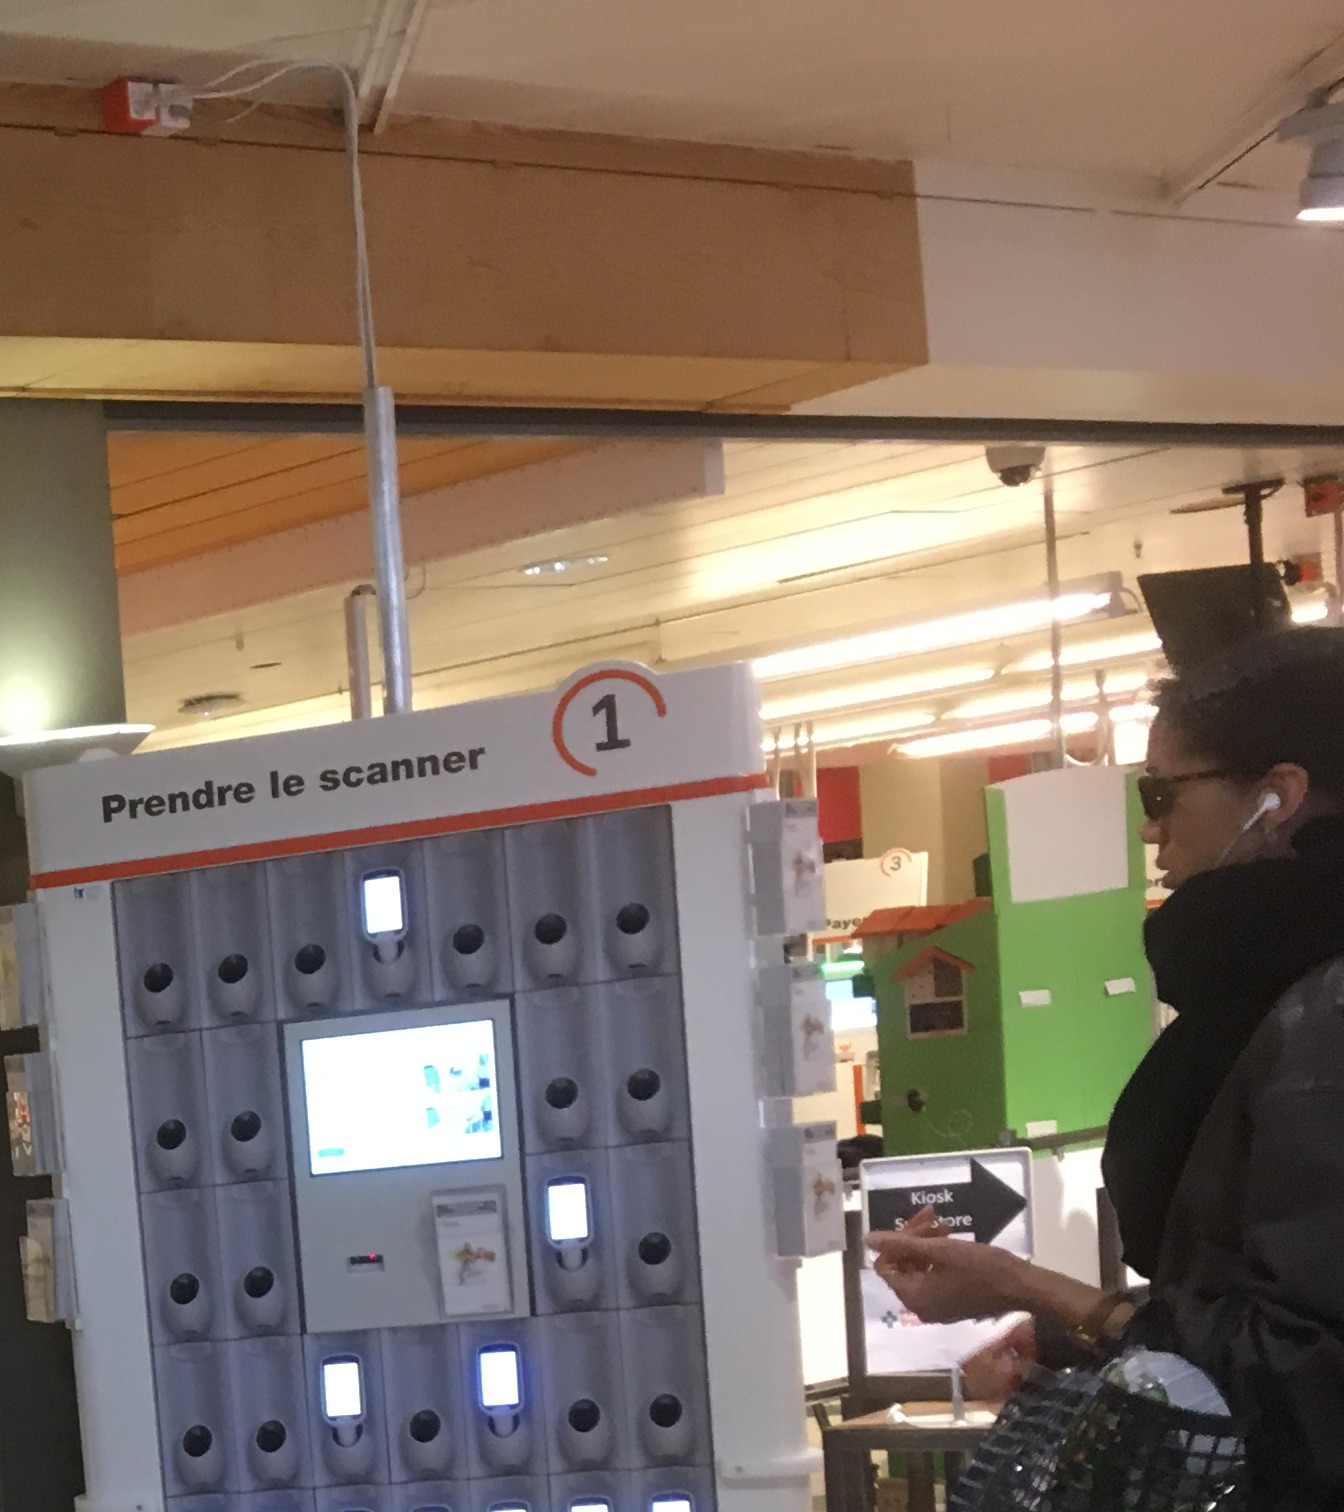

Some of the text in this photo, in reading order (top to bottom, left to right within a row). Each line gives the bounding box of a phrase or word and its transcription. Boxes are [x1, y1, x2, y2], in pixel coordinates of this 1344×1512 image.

[590, 693, 632, 753] 1
[101, 747, 486, 824] Prendre le scanner
[890, 856, 902, 871] 3
[826, 916, 866, 930] aye
[911, 1188, 954, 1205] Kiosk
